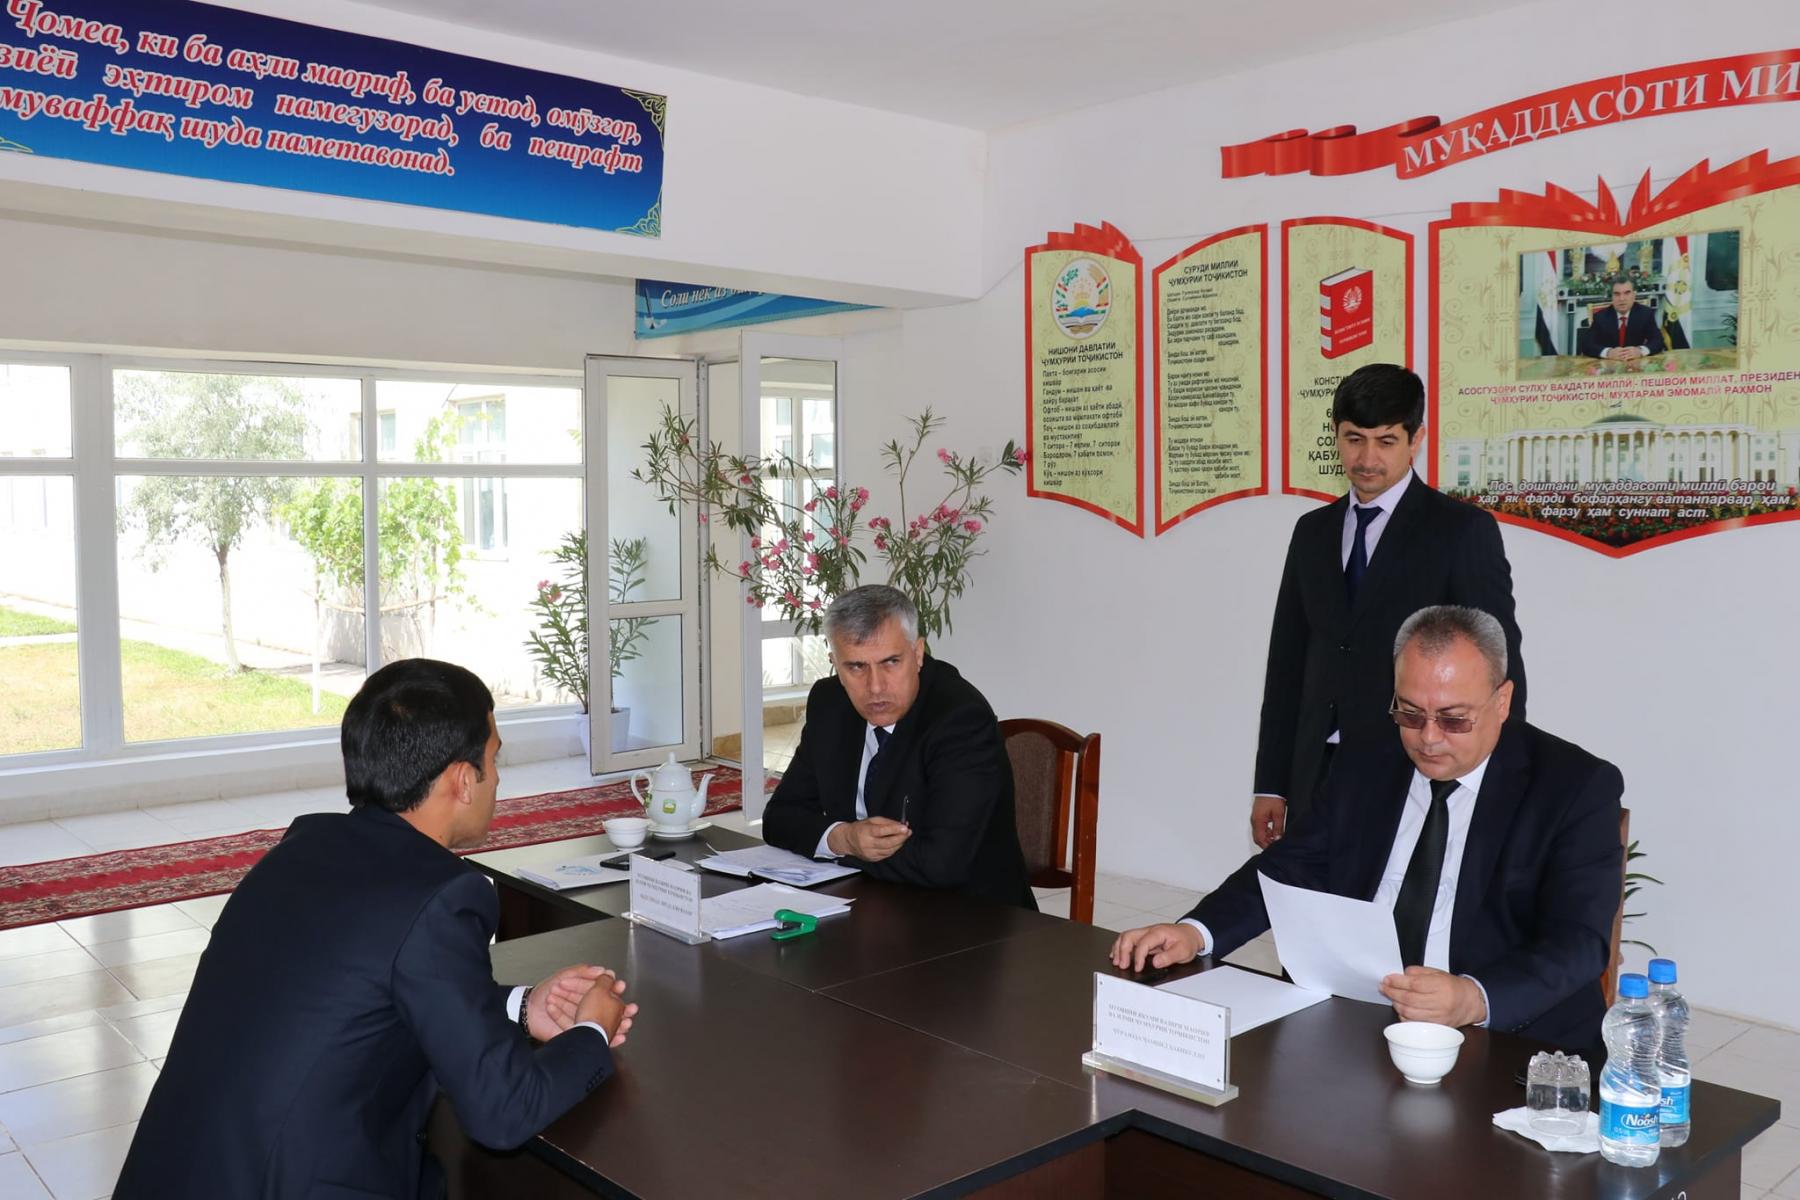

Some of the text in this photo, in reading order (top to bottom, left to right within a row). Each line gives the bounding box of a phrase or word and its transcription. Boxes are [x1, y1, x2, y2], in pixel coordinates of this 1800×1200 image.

[7, 0, 642, 145] Ҷомеа, ки ба аҳли маориф, ба устод, омӯзгор,
[103, 63, 253, 108] эҳтиром
[275, 94, 459, 146] намегузорад,
[480, 123, 511, 151] ба
[528, 136, 642, 175] пешрафт
[1403, 73, 1709, 174] МУҚАДДАСОТИ
[0, 87, 455, 176] муваффақ шуда наметавонад.
[662, 289, 689, 307] Соли
[1458, 385, 1516, 395] АСОСГУЗОРИ
[1641, 377, 1687, 387] ПЕШВОИ
[1519, 479, 1578, 491] доштани
[1585, 479, 1677, 494] муқаддасоти
[1729, 478, 1776, 494] барои
[1505, 495, 1518, 503] як
[1525, 494, 1566, 505] фарди
[1541, 507, 1581, 519] фарзу
[1619, 507, 1670, 519] суннат
